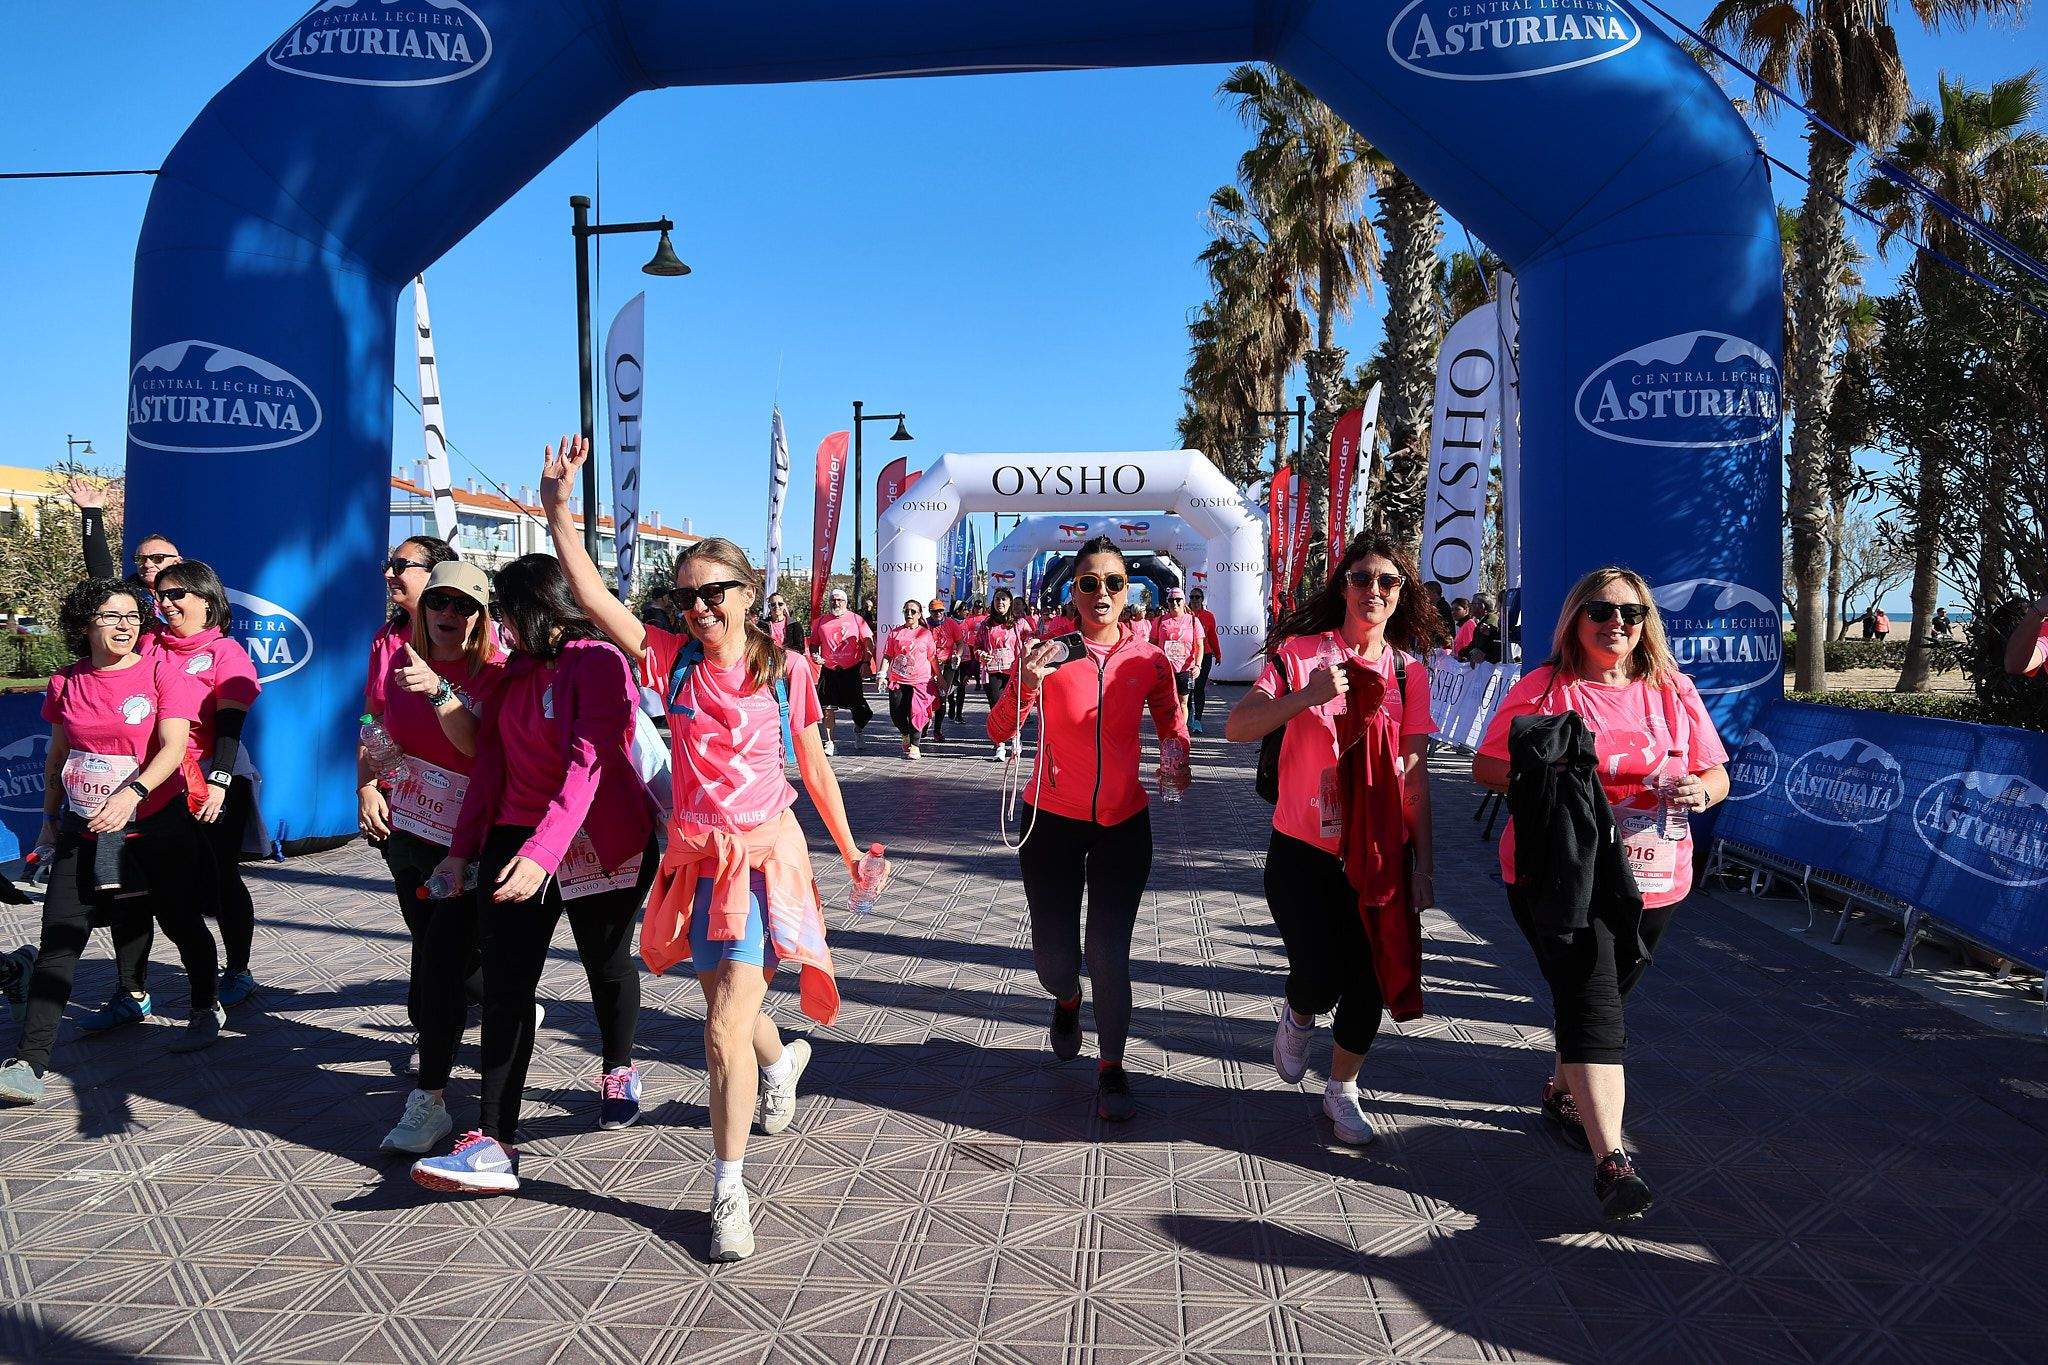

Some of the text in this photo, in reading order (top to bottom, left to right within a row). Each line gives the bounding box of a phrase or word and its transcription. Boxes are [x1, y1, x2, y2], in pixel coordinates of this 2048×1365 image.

[1448, 0, 1613, 18] CENTRAL LECHERA
[313, 12, 464, 27] CENTRAL LECHERA
[275, 26, 474, 64] ASTURIANA
[1407, 13, 1629, 60] ASTURIANA
[1632, 371, 1714, 386] CENTRAL
[142, 379, 295, 399] CENTRAL LECHERA
[128, 384, 303, 432] ASTURIANA
[1591, 379, 1779, 423] ASTURIANA
[1431, 348, 1495, 585] OYSHO
[991, 463, 1146, 496] OYSHO
[1334, 437, 1350, 532] Santander
[902, 501, 948, 512] OYSHO
[1190, 496, 1237, 509] OYSHO
[882, 562, 924, 573] OYSHO
[1216, 561, 1260, 572] OYSHO
[238, 620, 287, 632] HERA
[1216, 625, 1259, 635] OYSHO
[1664, 617, 1776, 629] NTRAL LECHERA
[1672, 634, 1778, 665] URIANA
[83, 783, 110, 795] 016
[1790, 763, 1893, 812] ASTURIANA
[417, 794, 444, 814] 016
[735, 809, 766, 824] MUJER
[1919, 791, 2048, 871] ASTURIAN
